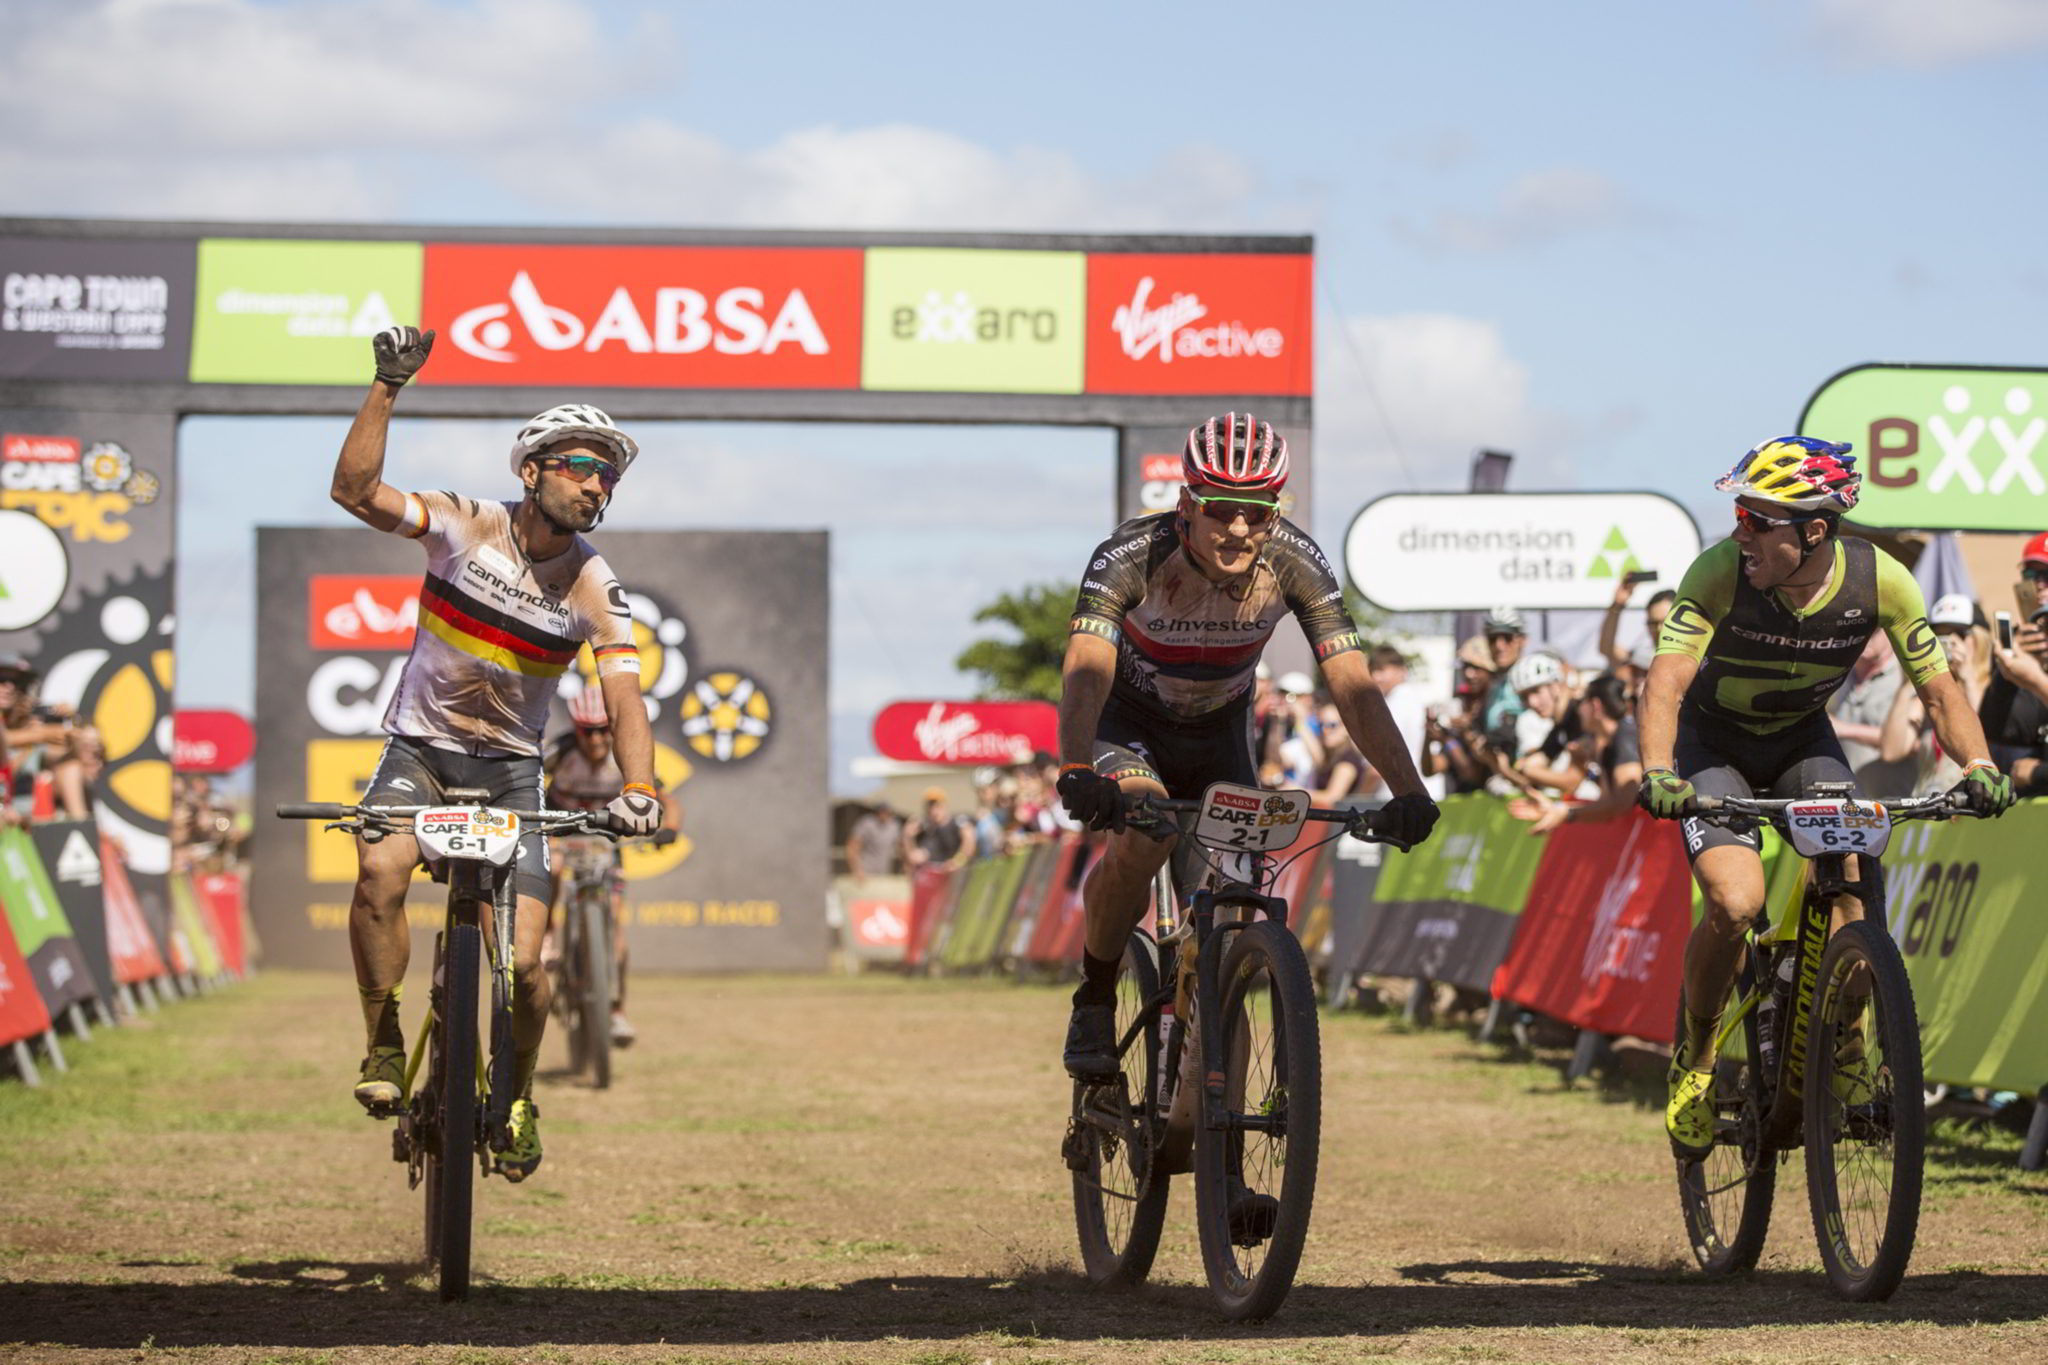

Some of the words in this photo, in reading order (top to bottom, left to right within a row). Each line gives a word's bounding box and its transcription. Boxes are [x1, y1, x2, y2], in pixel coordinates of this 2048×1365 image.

[216, 288, 348, 314] dimension
[584, 286, 830, 355] ABSA
[892, 291, 1057, 342] exxaro
[1113, 276, 1206, 362] Virgin
[1176, 321, 1284, 357] active
[1103, 527, 1169, 561] Investec
[1399, 524, 1575, 552] dimension
[1500, 553, 1575, 581] data
[467, 560, 570, 619] cannondale
[1169, 618, 1268, 632] Investec
[1731, 625, 1866, 650] cannondale
[1208, 806, 1257, 826] CAPE
[1258, 812, 1299, 827] EPIC
[1230, 799, 1256, 808] ABSA
[422, 824, 468, 834] CAPE
[472, 824, 513, 838] EPIC
[1795, 817, 1842, 828] CAPE
[1844, 817, 1885, 829] EPIC
[448, 836, 487, 852] 6-1
[1230, 828, 1269, 845] 2-1
[1821, 830, 1867, 847] 6-2
[1886, 824, 1980, 958] xxaro
